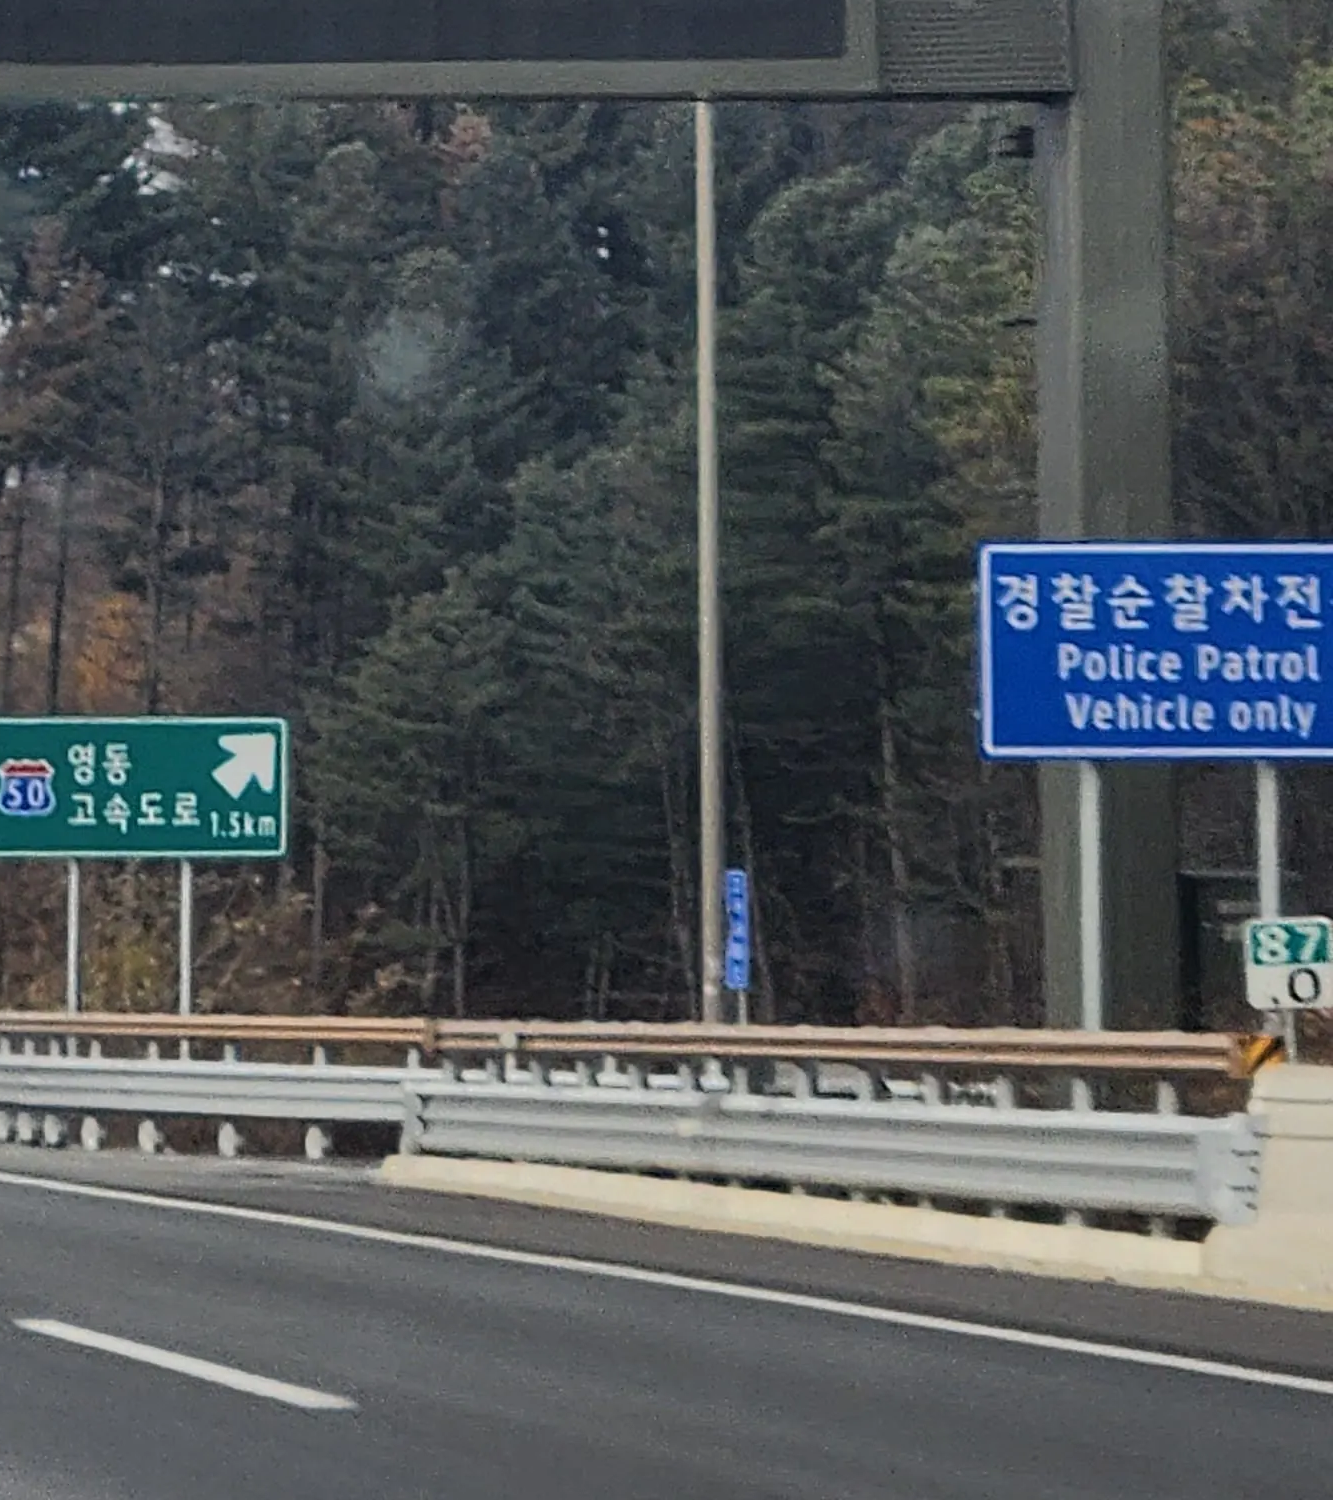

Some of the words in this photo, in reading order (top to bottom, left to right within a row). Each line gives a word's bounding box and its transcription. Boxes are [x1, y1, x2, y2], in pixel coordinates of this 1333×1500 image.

[996, 573, 1333, 631] 경찰순찰차전
[1057, 643, 1183, 682] Police
[1197, 643, 1321, 682] Patrol
[1065, 693, 1215, 731] Vehicle
[1229, 694, 1316, 739] only
[67, 742, 132, 786] 영동
[8, 781, 46, 808] 50
[67, 792, 201, 834] 고속도로
[210, 811, 276, 838] 1.5km
[1256, 925, 1321, 963] 87
